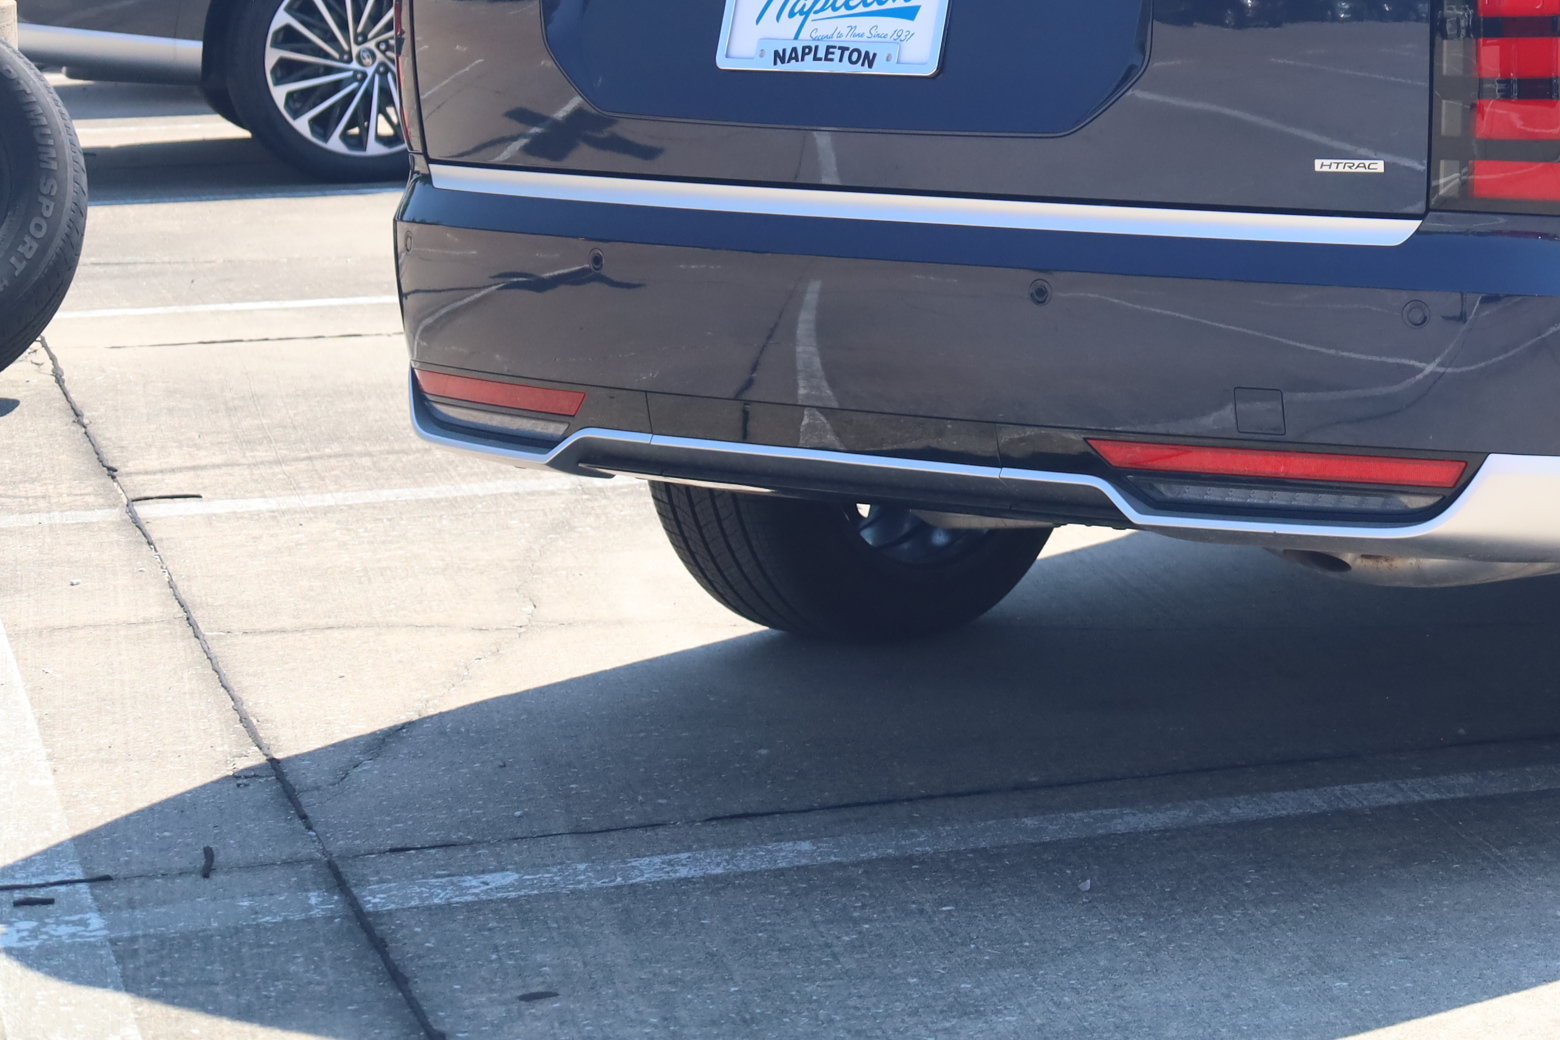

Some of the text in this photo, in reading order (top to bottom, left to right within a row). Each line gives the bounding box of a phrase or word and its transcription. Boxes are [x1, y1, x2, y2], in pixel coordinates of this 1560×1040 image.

[845, 24, 866, 41] None
[866, 24, 889, 40] Since
[889, 27, 915, 43] 1931
[772, 44, 878, 69] NAPLETON
[1320, 161, 1379, 170] HTRAC
[10, 175, 57, 277] SPORT
